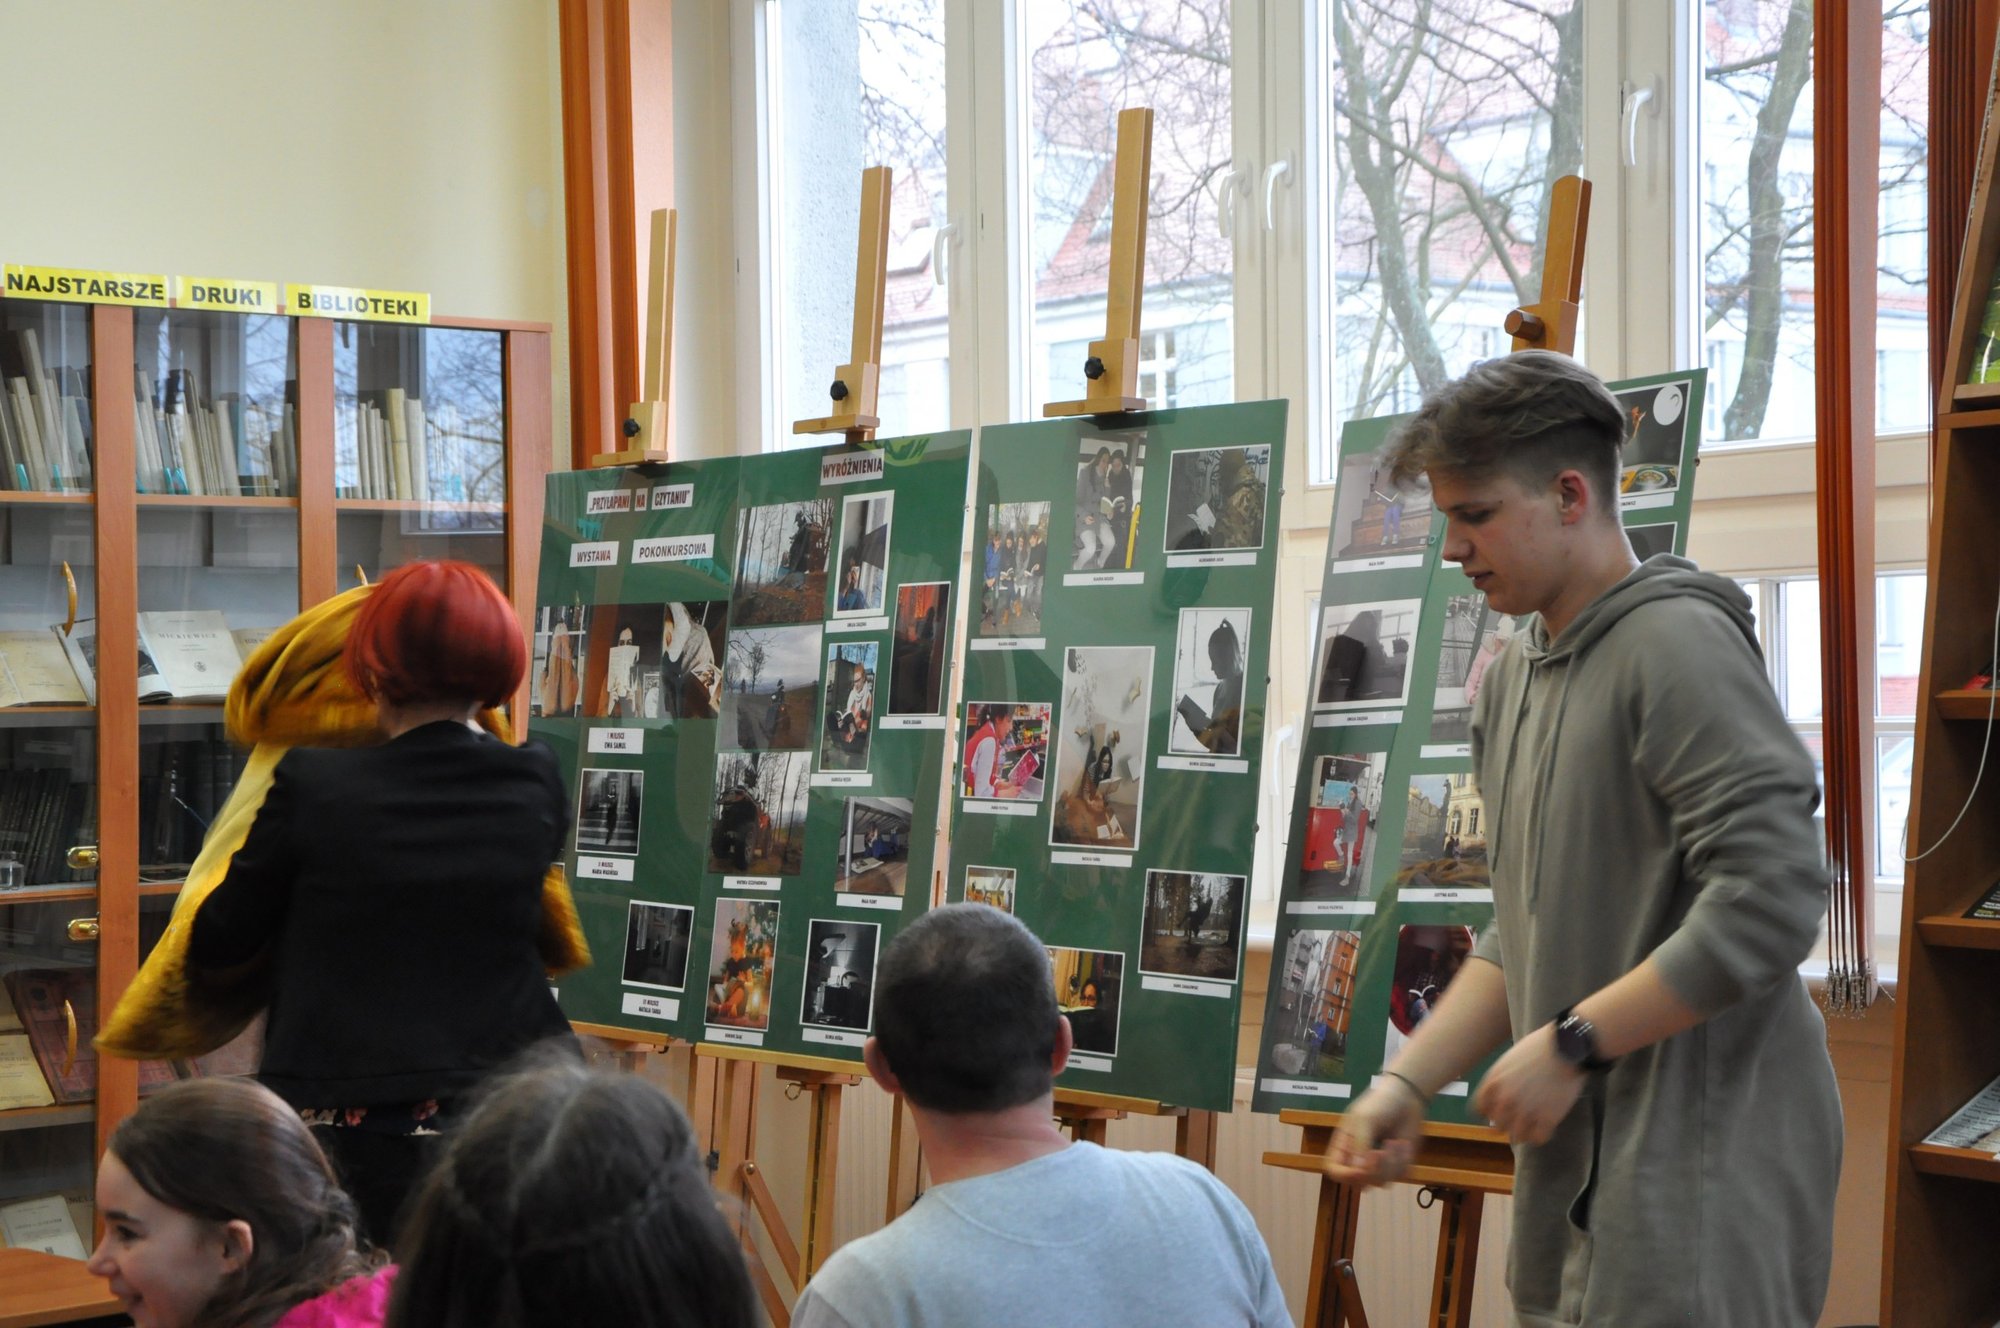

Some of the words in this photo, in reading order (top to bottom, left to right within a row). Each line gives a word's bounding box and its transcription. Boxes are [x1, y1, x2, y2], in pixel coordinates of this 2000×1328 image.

[7, 273, 164, 301] NAJSTARSZE
[191, 285, 262, 306] DRUKI
[297, 292, 418, 317] BIBLIOTEKI
[822, 457, 884, 479] WYRÓŻNIENIA
[636, 494, 646, 508] NA
[576, 550, 611, 563] WYSTAWA
[639, 543, 707, 558] POKONKURSOWA
